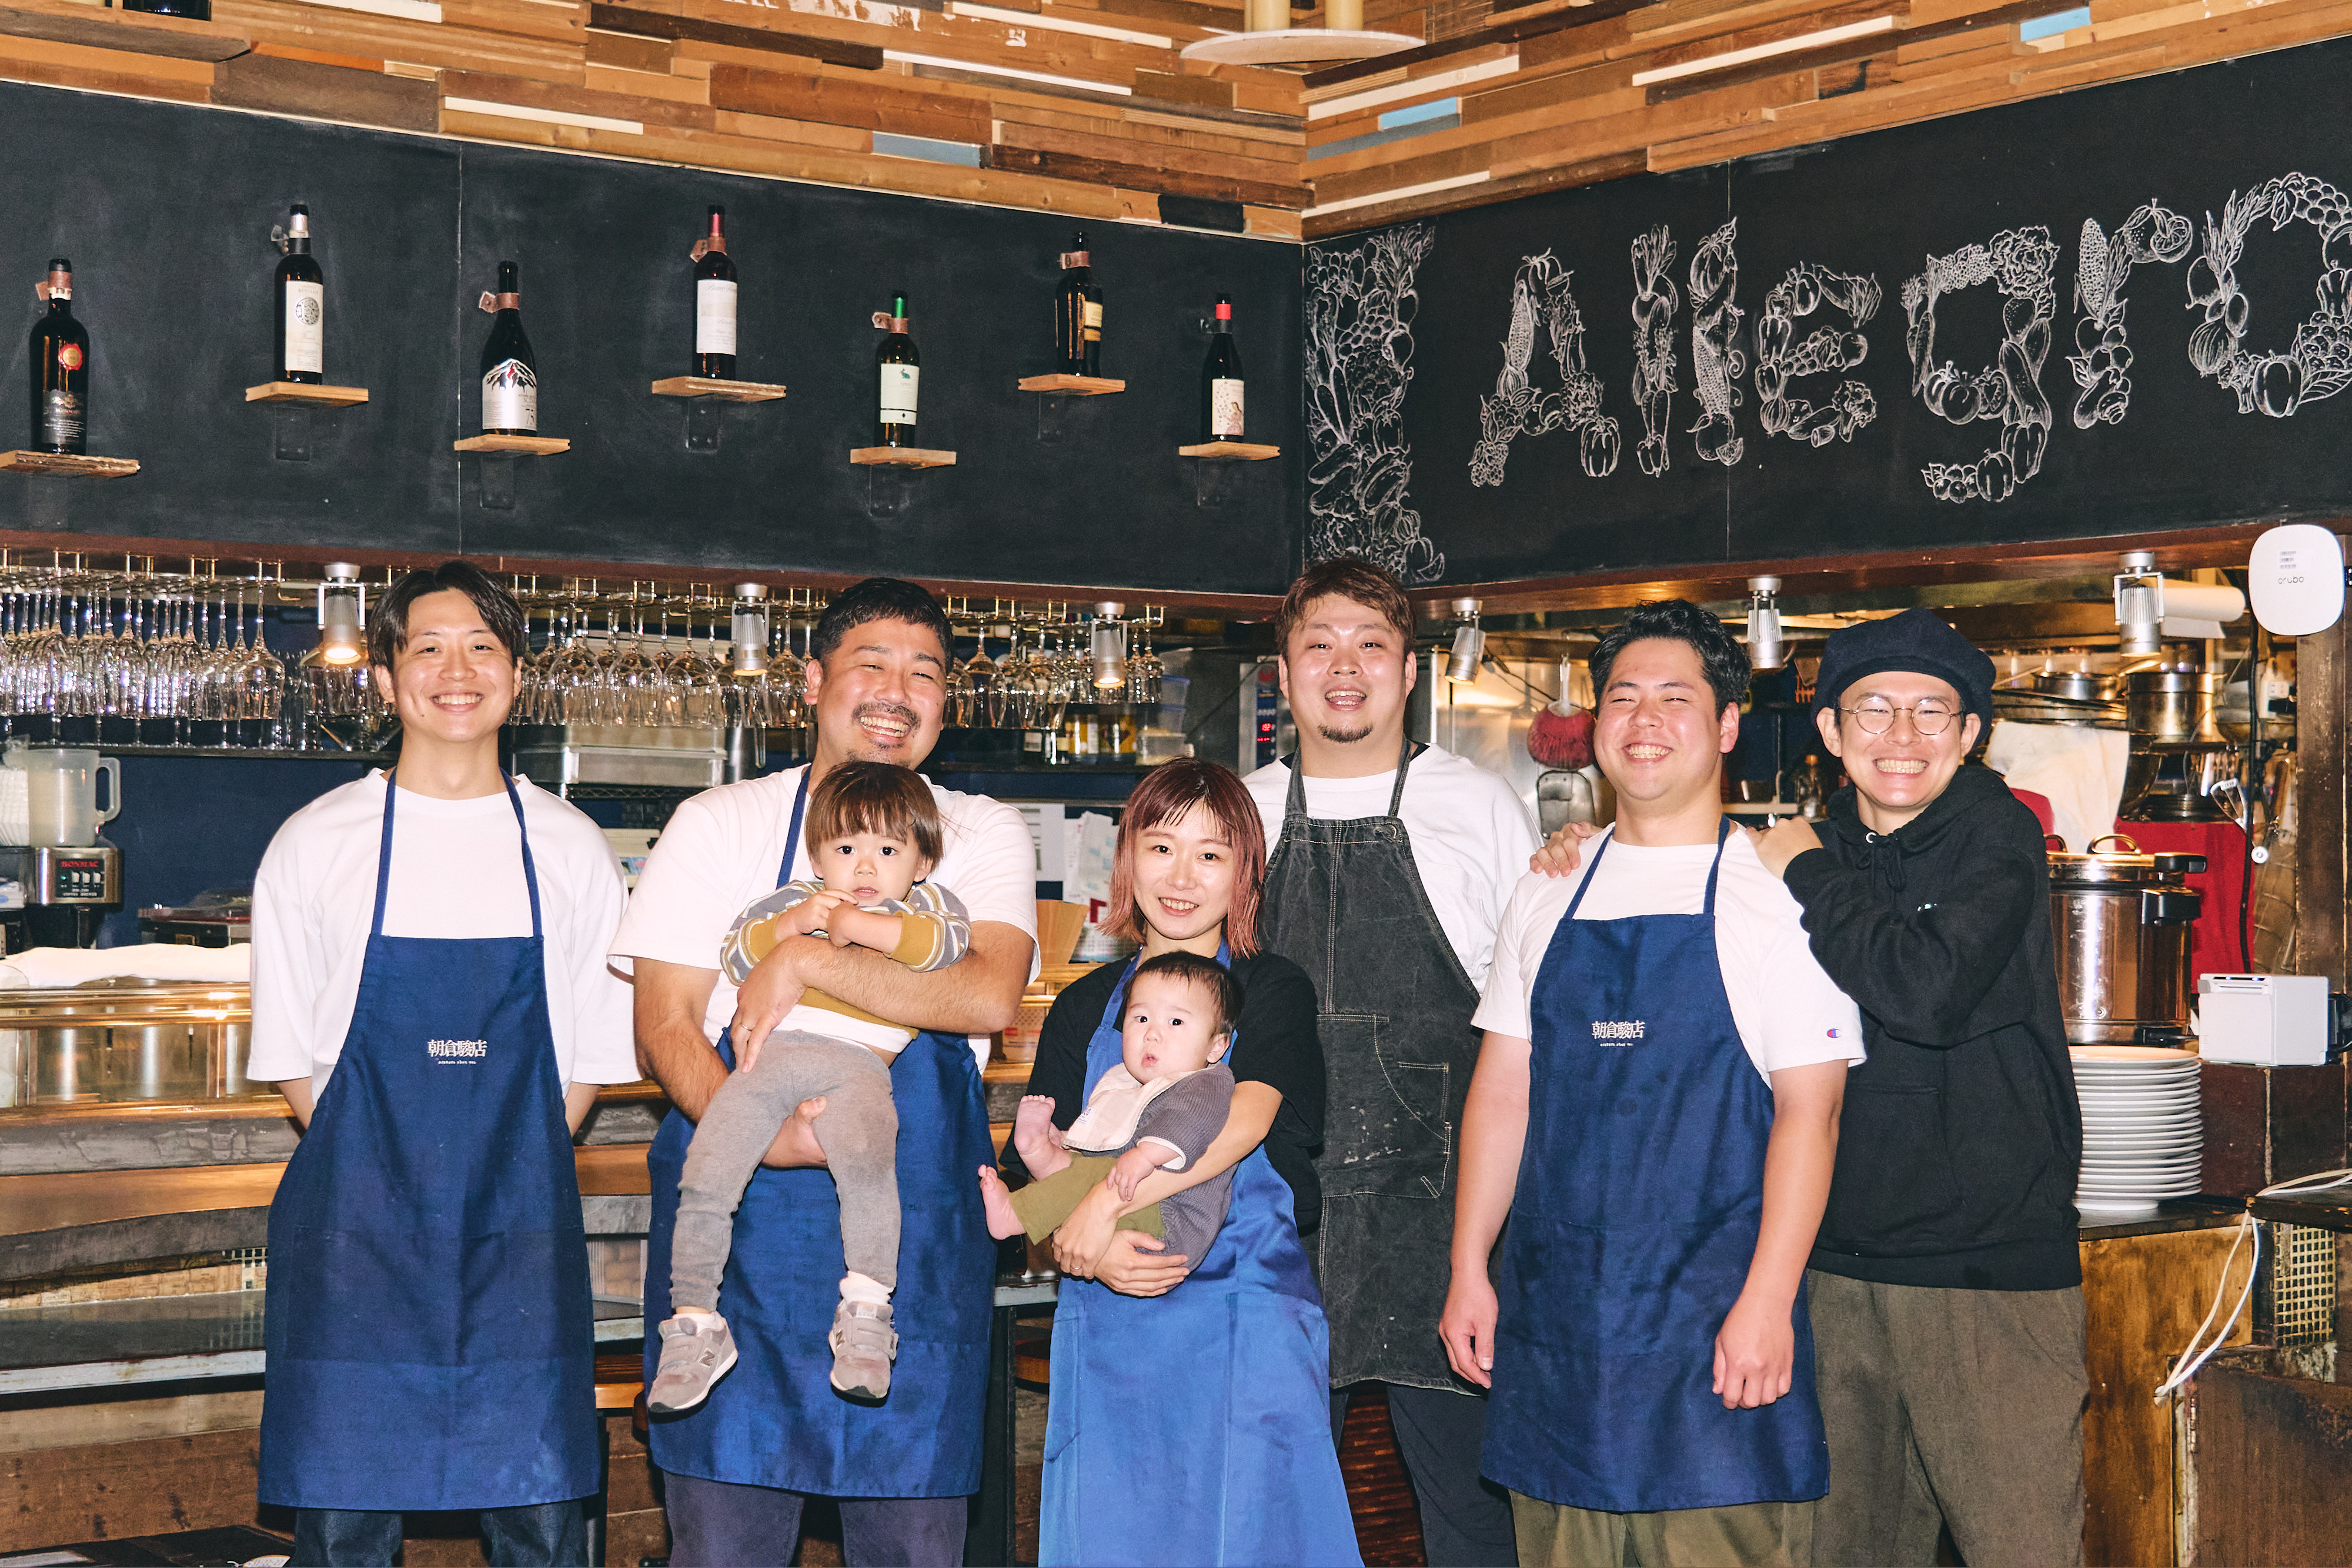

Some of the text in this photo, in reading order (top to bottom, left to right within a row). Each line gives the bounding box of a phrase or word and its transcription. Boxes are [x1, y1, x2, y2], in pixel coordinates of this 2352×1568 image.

[2278, 576, 2304, 584] aruba
[427, 1039, 488, 1057] 朝倉駿店
